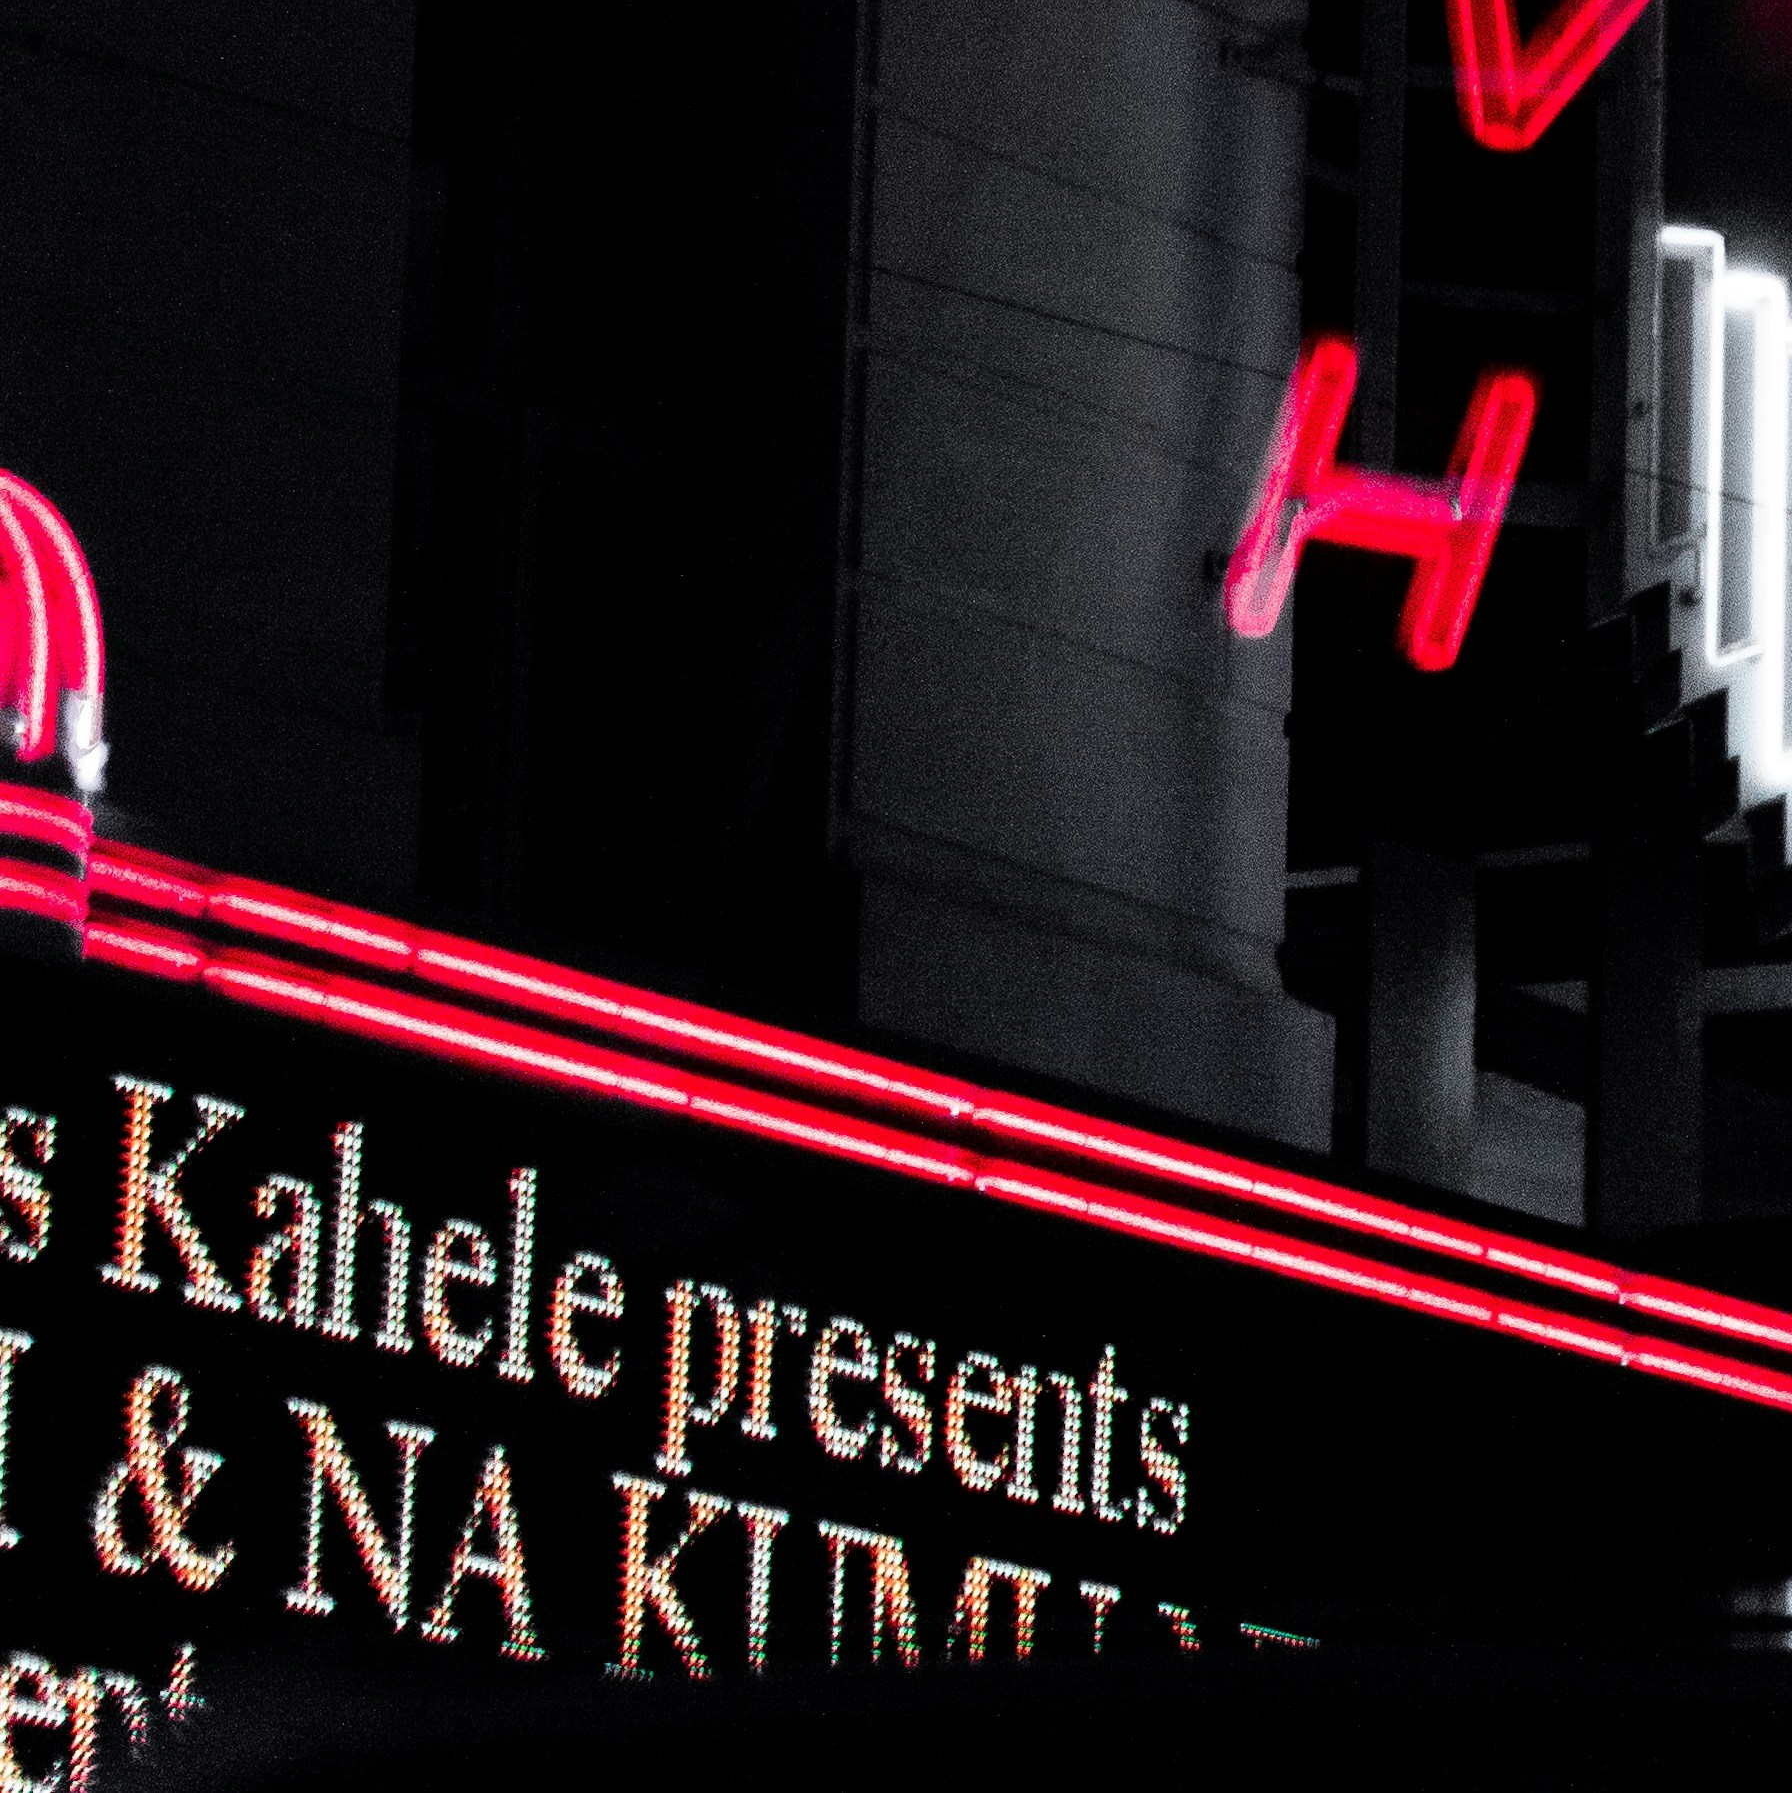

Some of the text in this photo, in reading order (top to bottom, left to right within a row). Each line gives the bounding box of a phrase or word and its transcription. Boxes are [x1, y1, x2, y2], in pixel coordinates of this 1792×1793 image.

[102, 1074, 625, 1400] Kahele
[655, 1280, 1190, 1535] presents
[91, 1365, 236, 1593] &
[286, 1397, 548, 1662] NA
